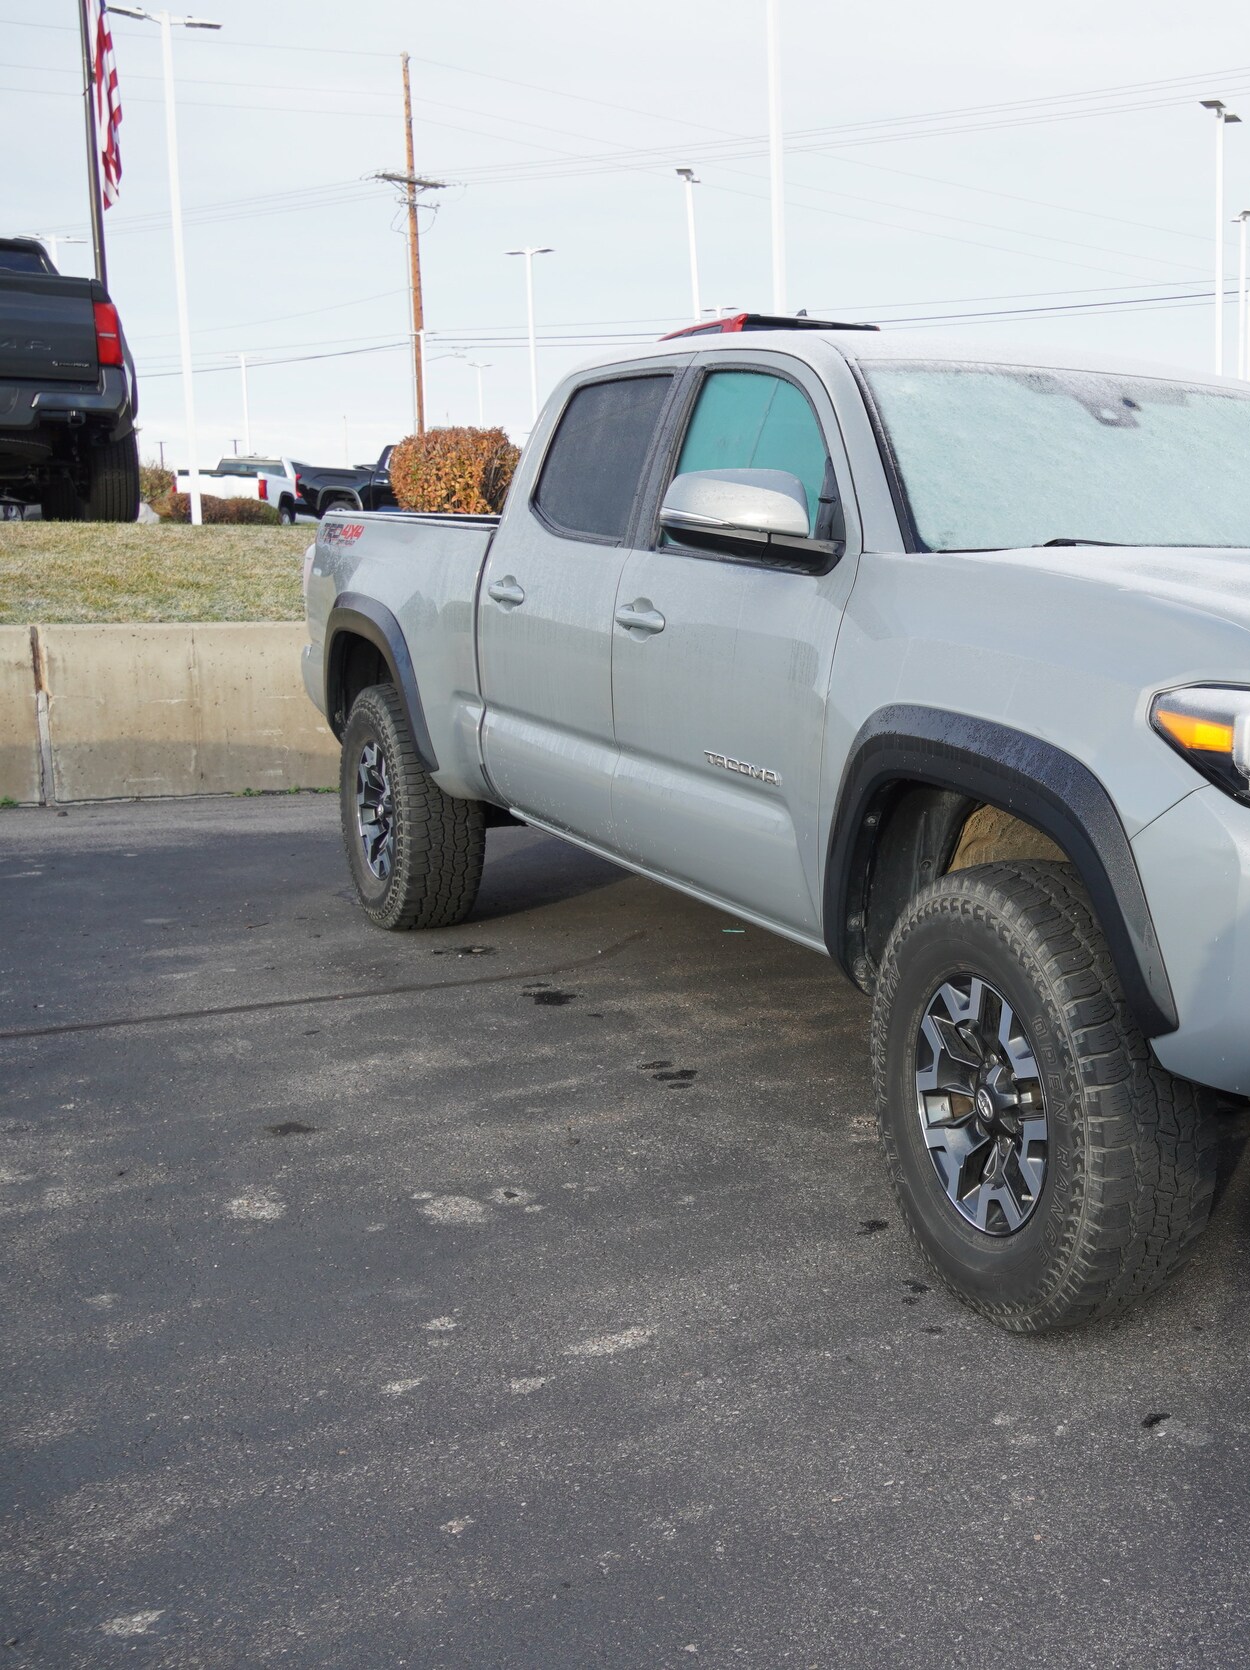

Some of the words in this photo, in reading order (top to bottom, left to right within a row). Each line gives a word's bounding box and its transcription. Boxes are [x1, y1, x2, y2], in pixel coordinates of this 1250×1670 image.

[703, 750, 783, 787] TACOMA
[1031, 1015, 1069, 1125] OPEN
[1035, 1142, 1070, 1267] RANGE
